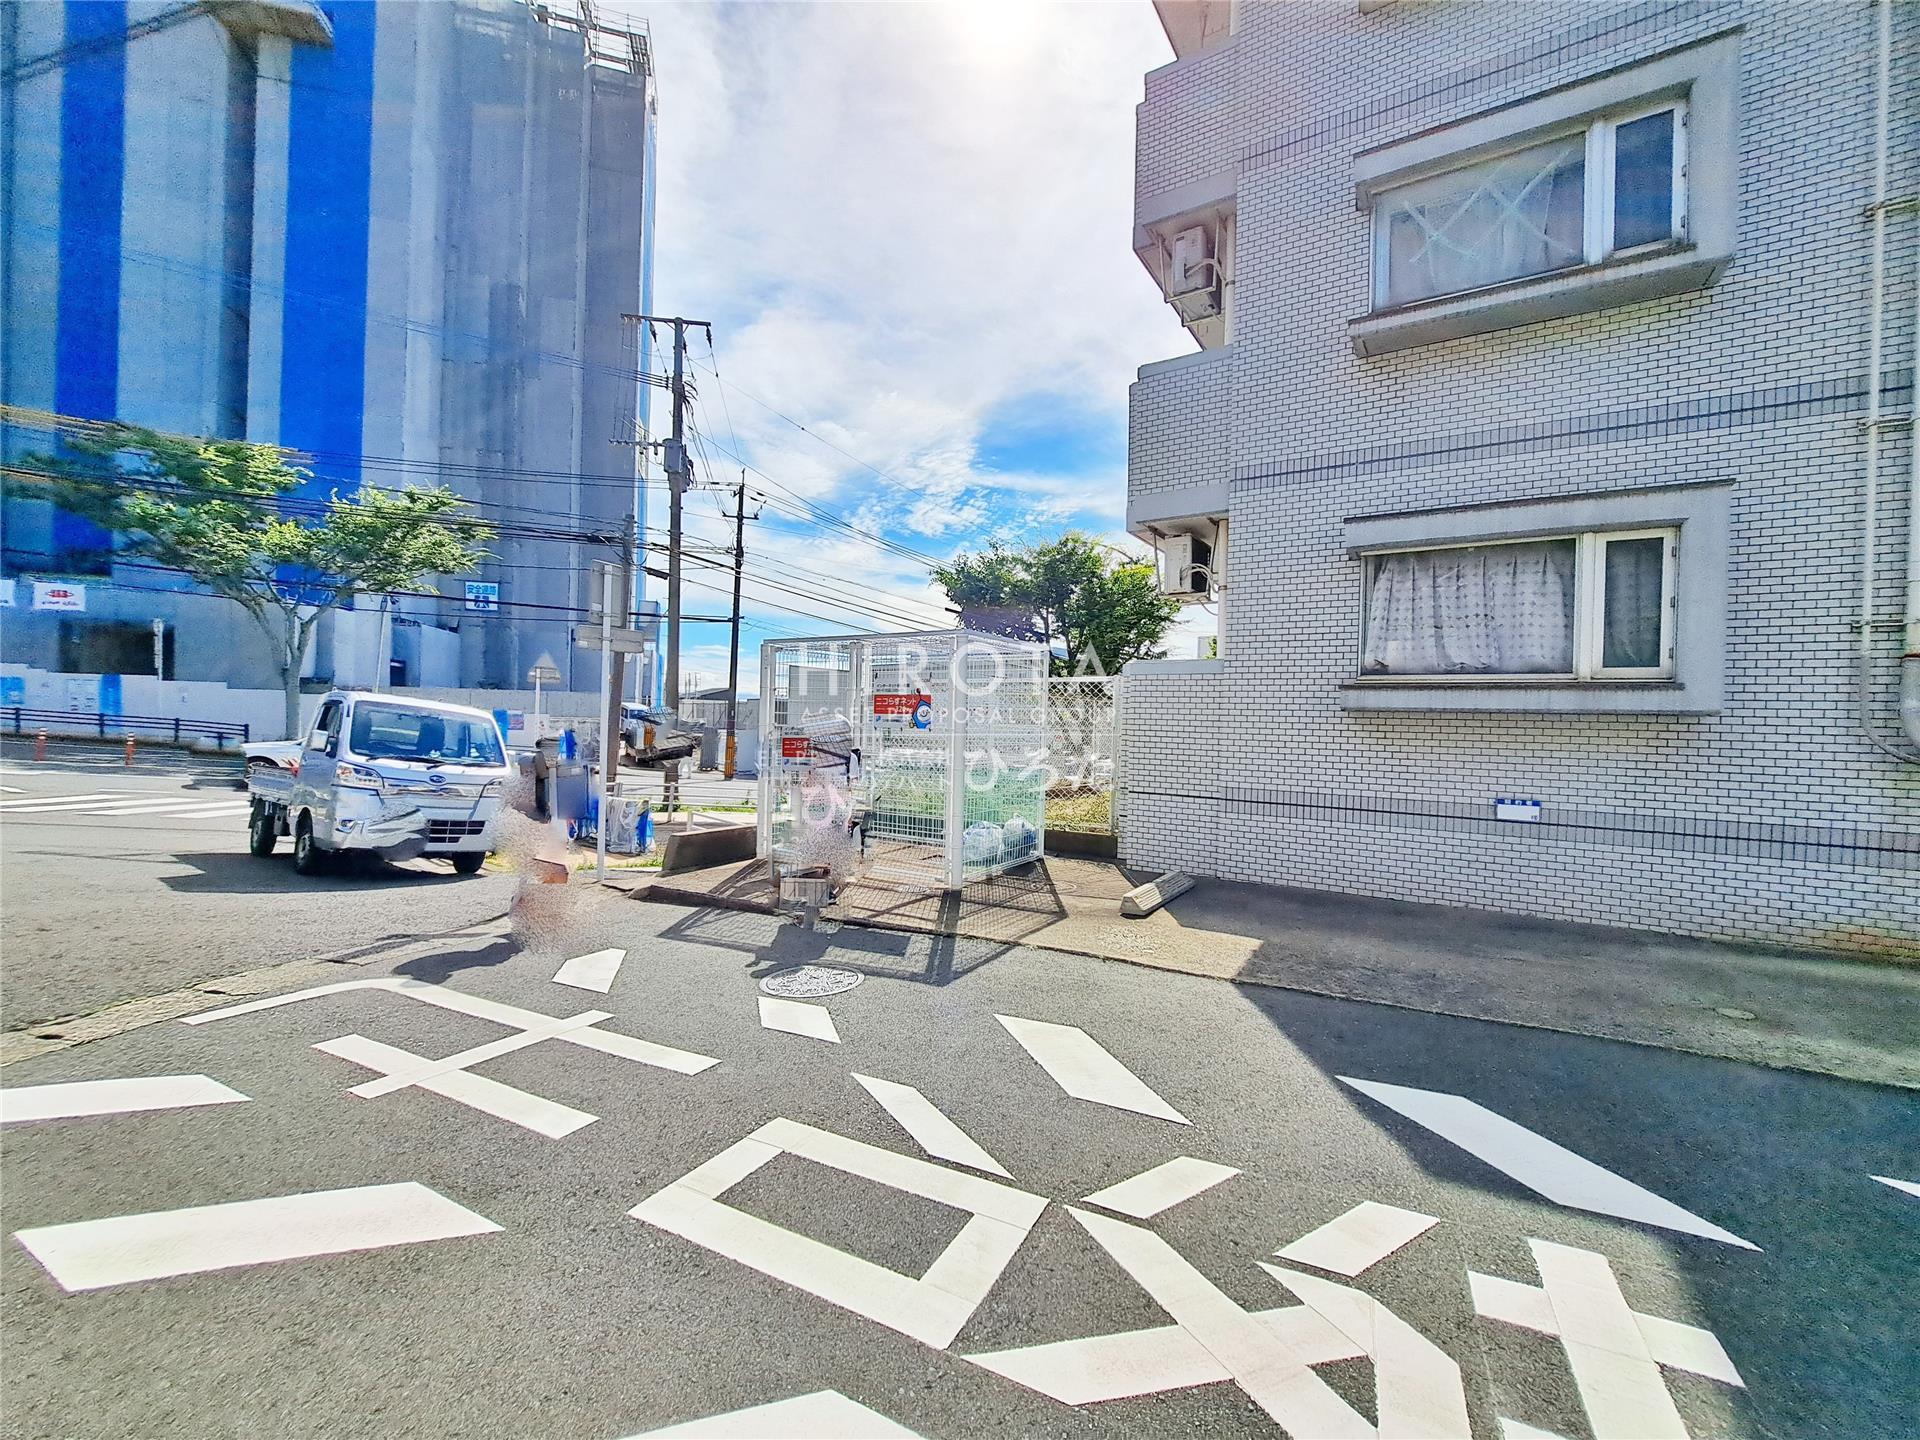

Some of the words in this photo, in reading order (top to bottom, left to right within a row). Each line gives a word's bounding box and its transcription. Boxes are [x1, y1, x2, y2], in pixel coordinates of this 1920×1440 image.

[875, 696, 916, 705] ニコらすネット
